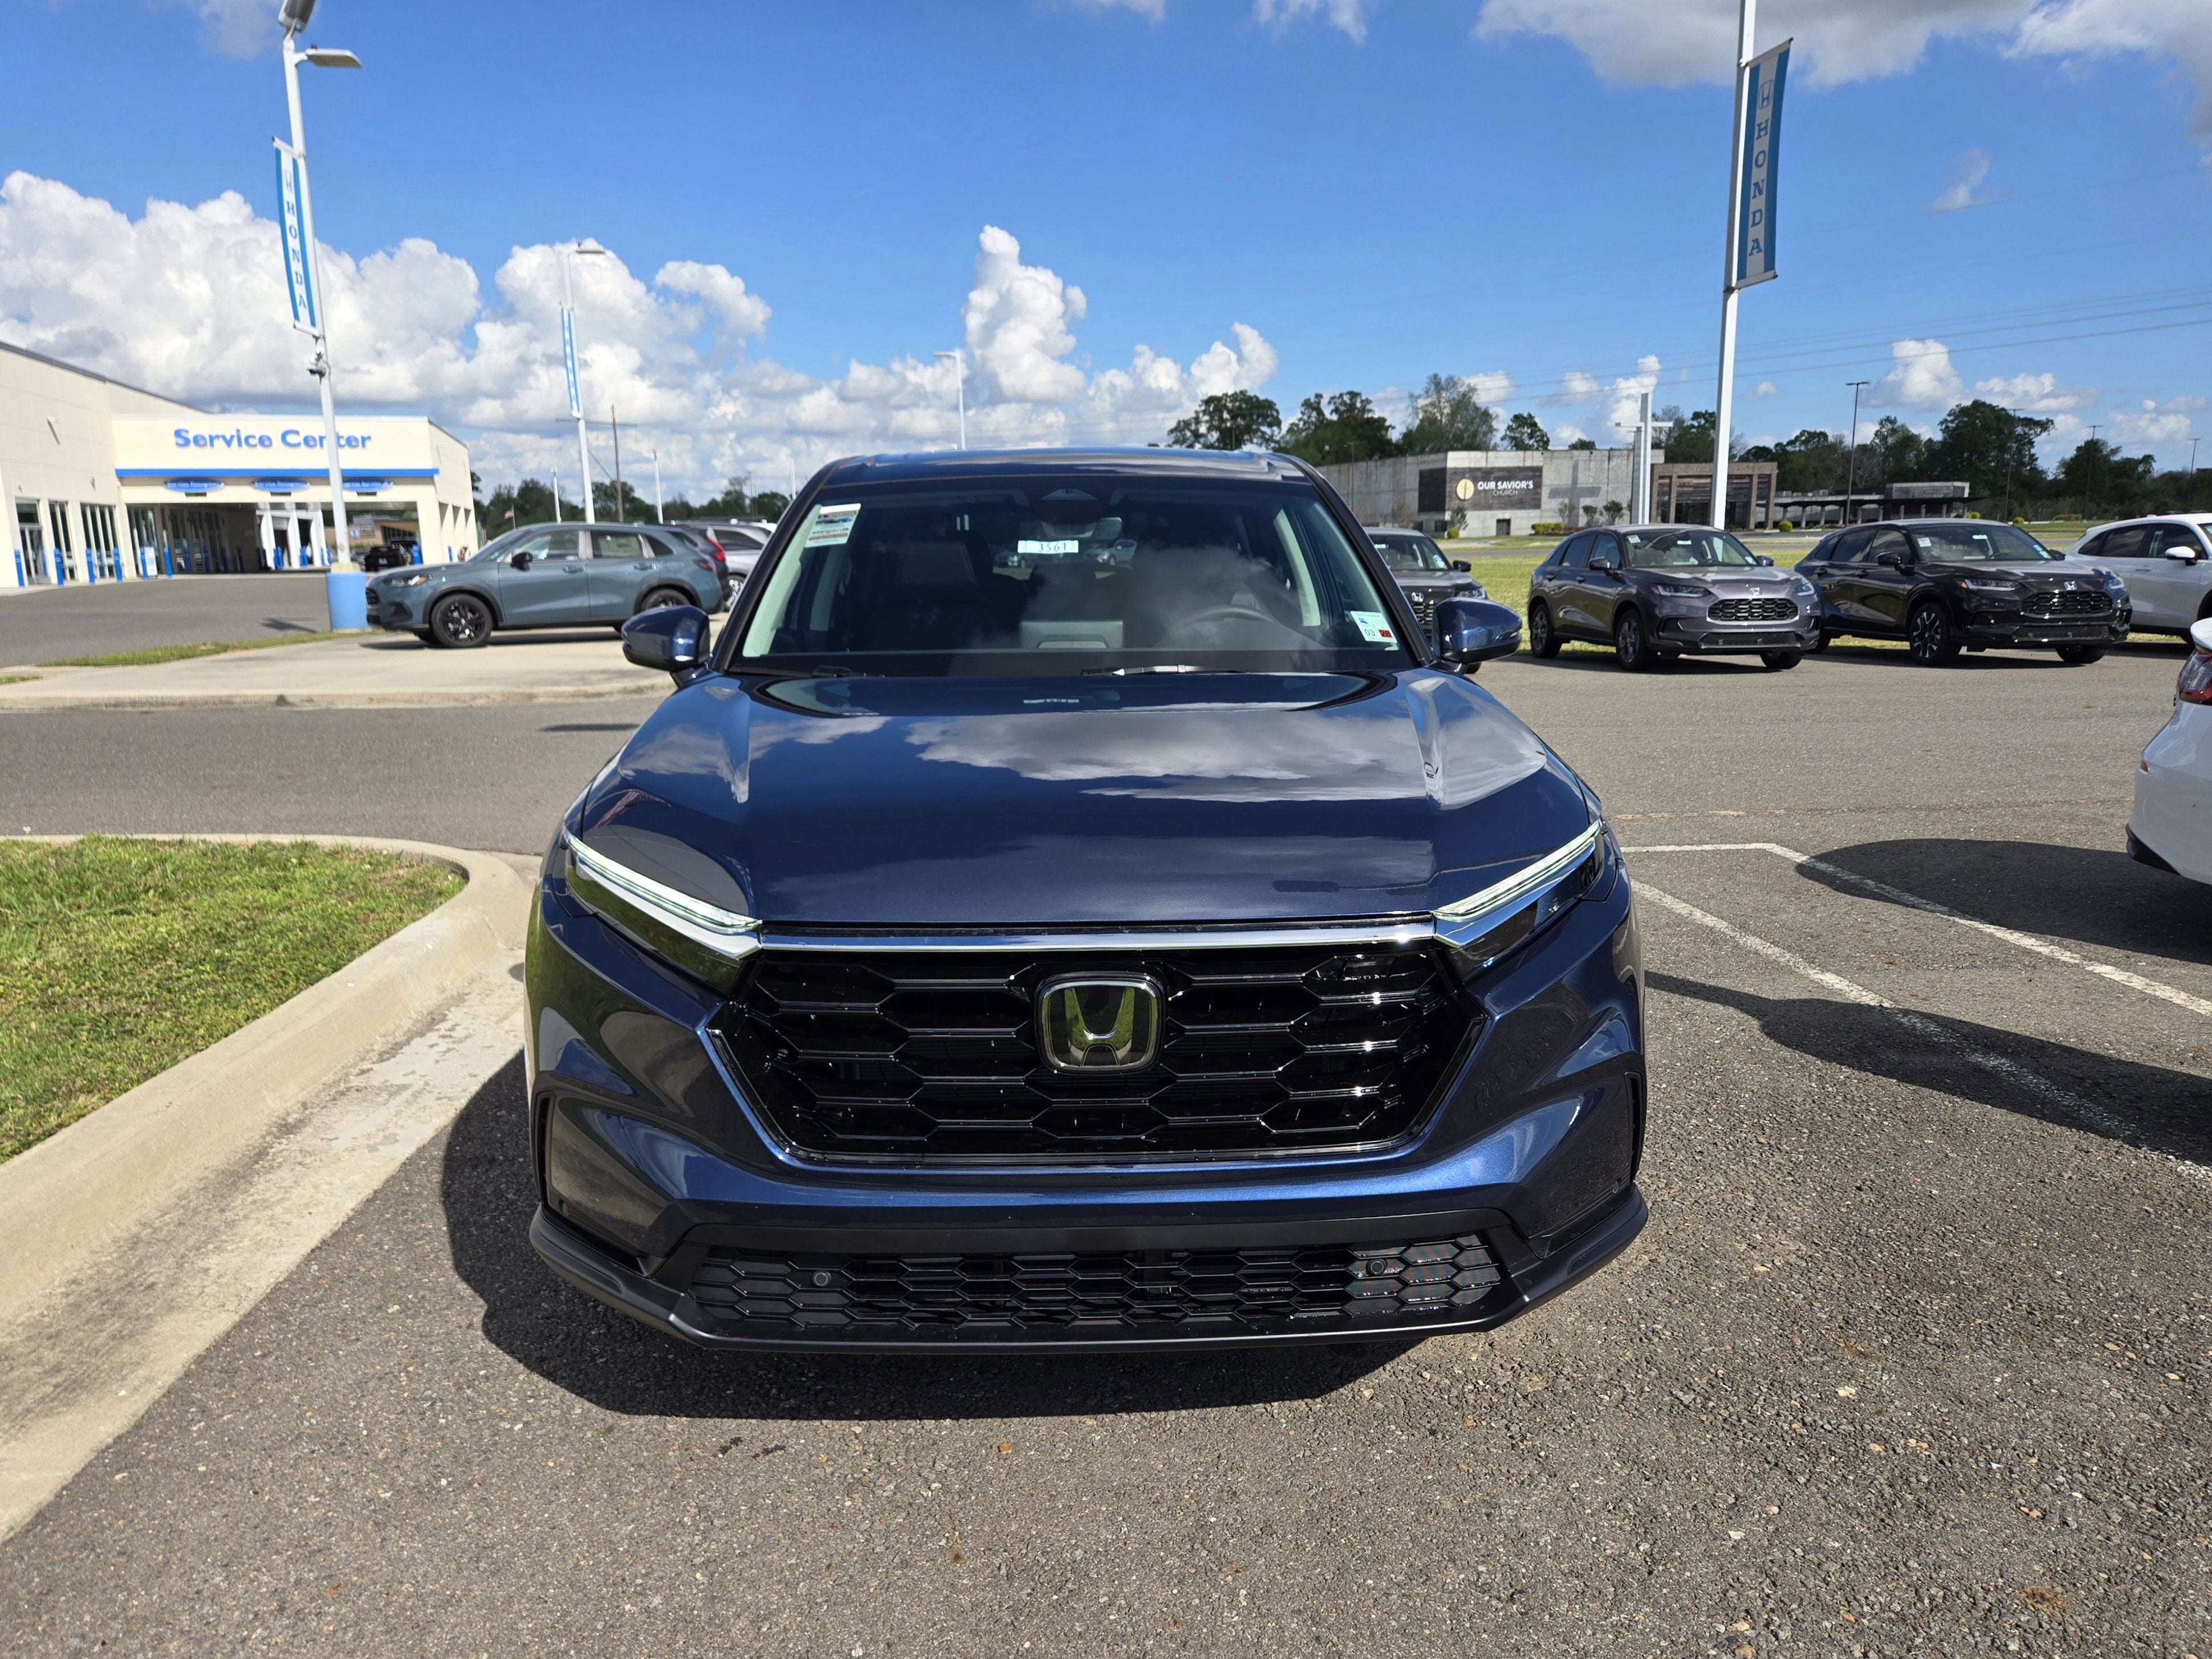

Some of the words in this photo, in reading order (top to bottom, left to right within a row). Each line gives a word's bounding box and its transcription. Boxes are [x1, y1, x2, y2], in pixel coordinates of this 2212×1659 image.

[1749, 119, 1770, 256] HONDA
[286, 201, 307, 308] HONDA
[174, 428, 273, 448] Service
[1477, 481, 1496, 490] OUR
[1497, 480, 1534, 489] SAVIOR'S
[1039, 542, 1066, 552] 3561
